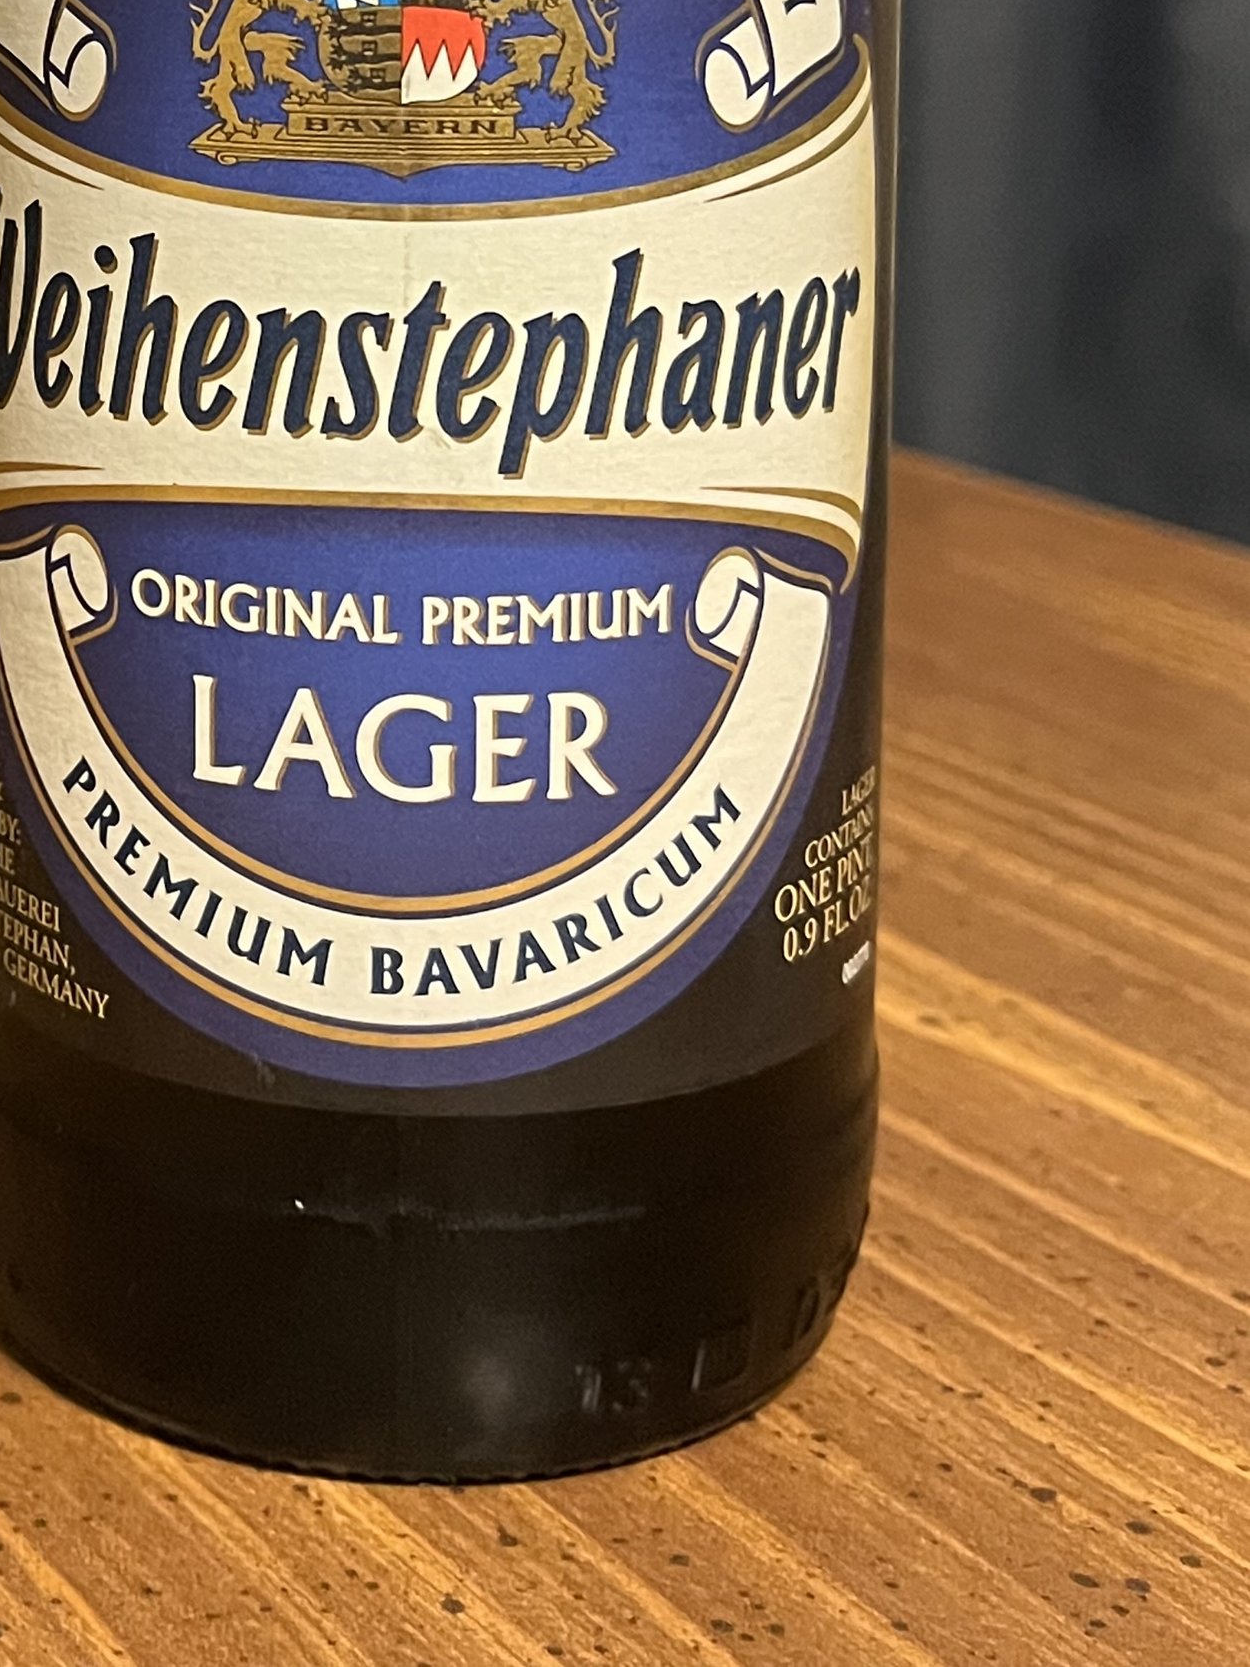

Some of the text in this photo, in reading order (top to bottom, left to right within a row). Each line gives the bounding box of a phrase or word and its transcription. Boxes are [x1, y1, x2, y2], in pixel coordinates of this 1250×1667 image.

[304, 116, 497, 135] BAYERN
[131, 568, 673, 648] ORIGINAL PREMIUM
[190, 674, 619, 804] LAGER
[61, 754, 744, 998] PREMIUM BAVARICUM
[774, 832, 873, 923] ONE PINT
[783, 917, 818, 963] 0.9
[3, 946, 110, 1019] GERMANY
